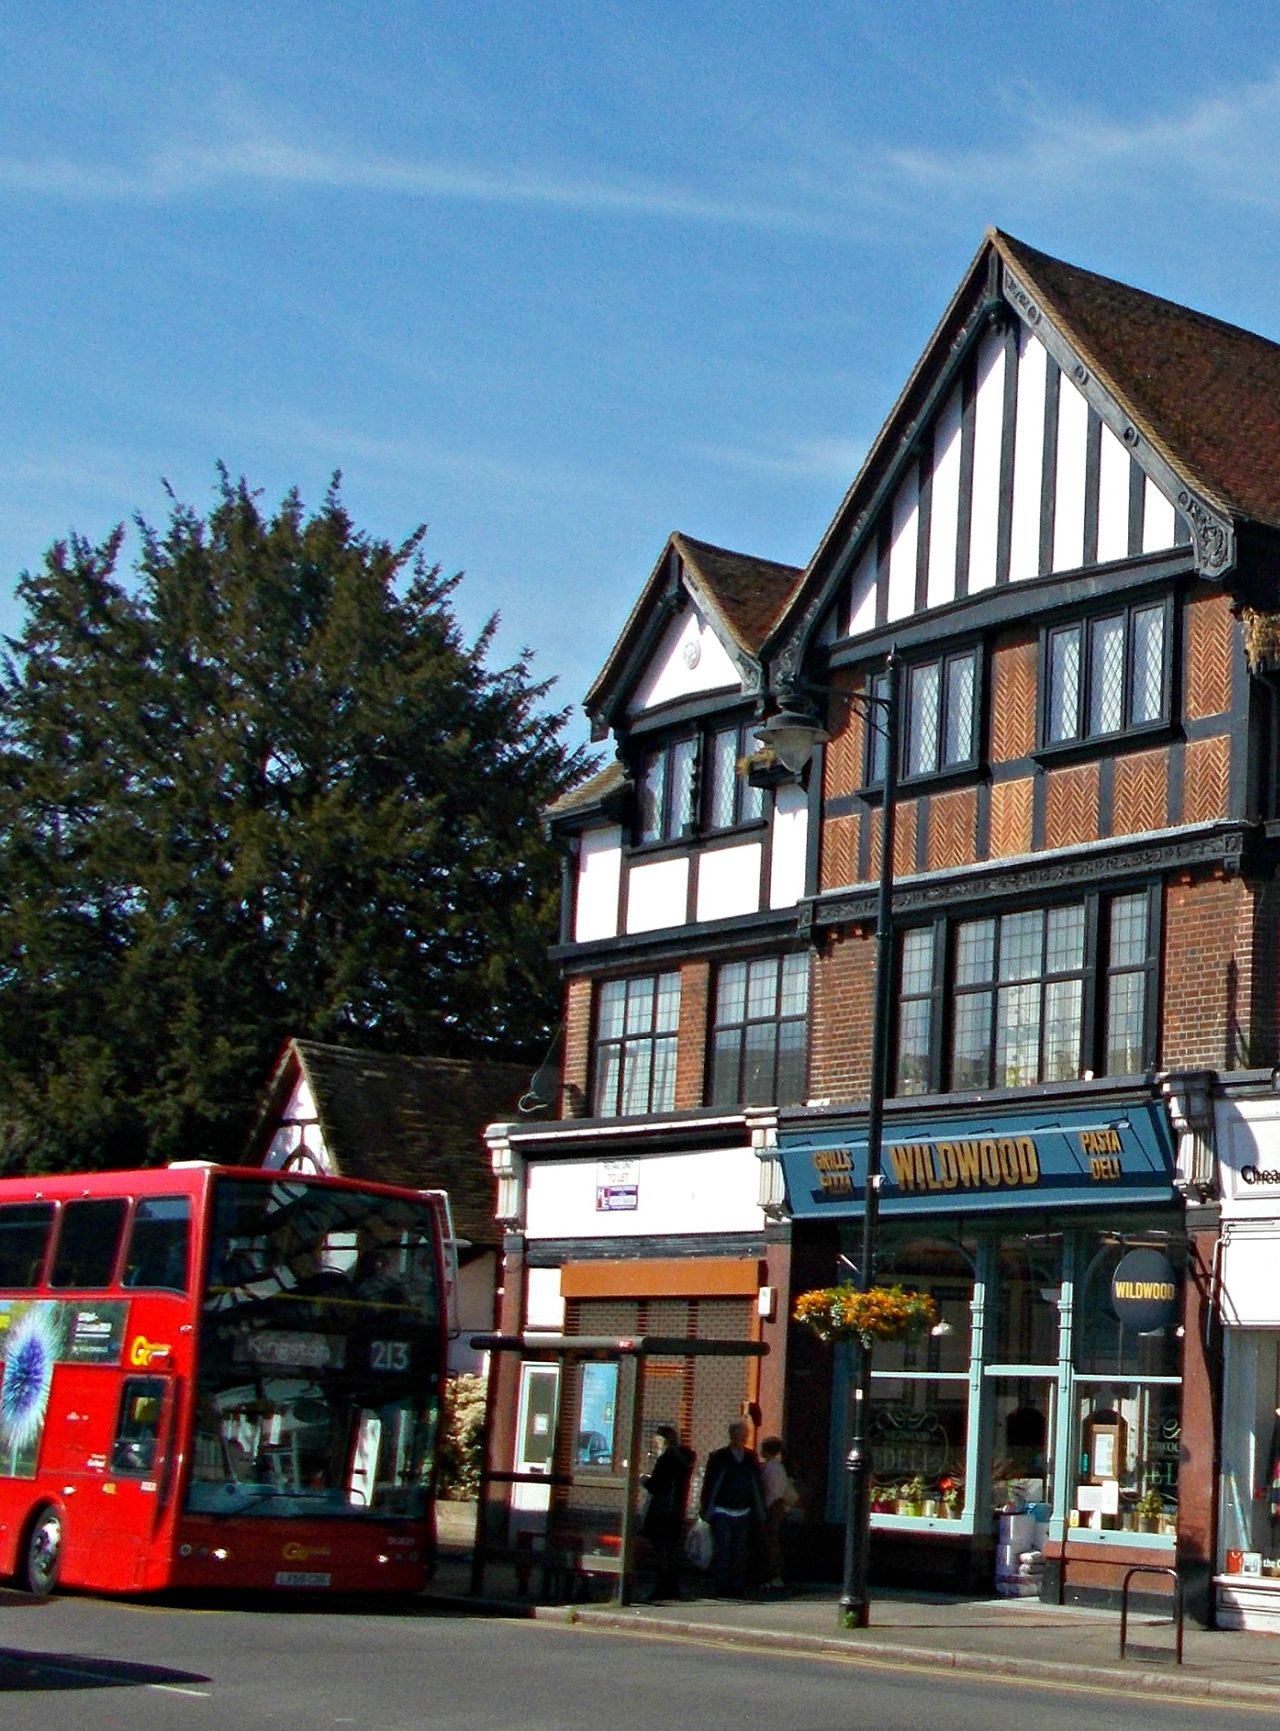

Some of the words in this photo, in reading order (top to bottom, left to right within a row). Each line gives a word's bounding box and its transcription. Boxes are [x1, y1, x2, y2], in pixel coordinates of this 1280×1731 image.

[1080, 1130, 1122, 1153] PASTA
[814, 1150, 852, 1169] GRILLS
[889, 1136, 1039, 1191] WILDWOOD
[1090, 1157, 1120, 1179] DELI
[1115, 1281, 1175, 1300] WILDWOOD
[371, 1340, 410, 1370] 213
